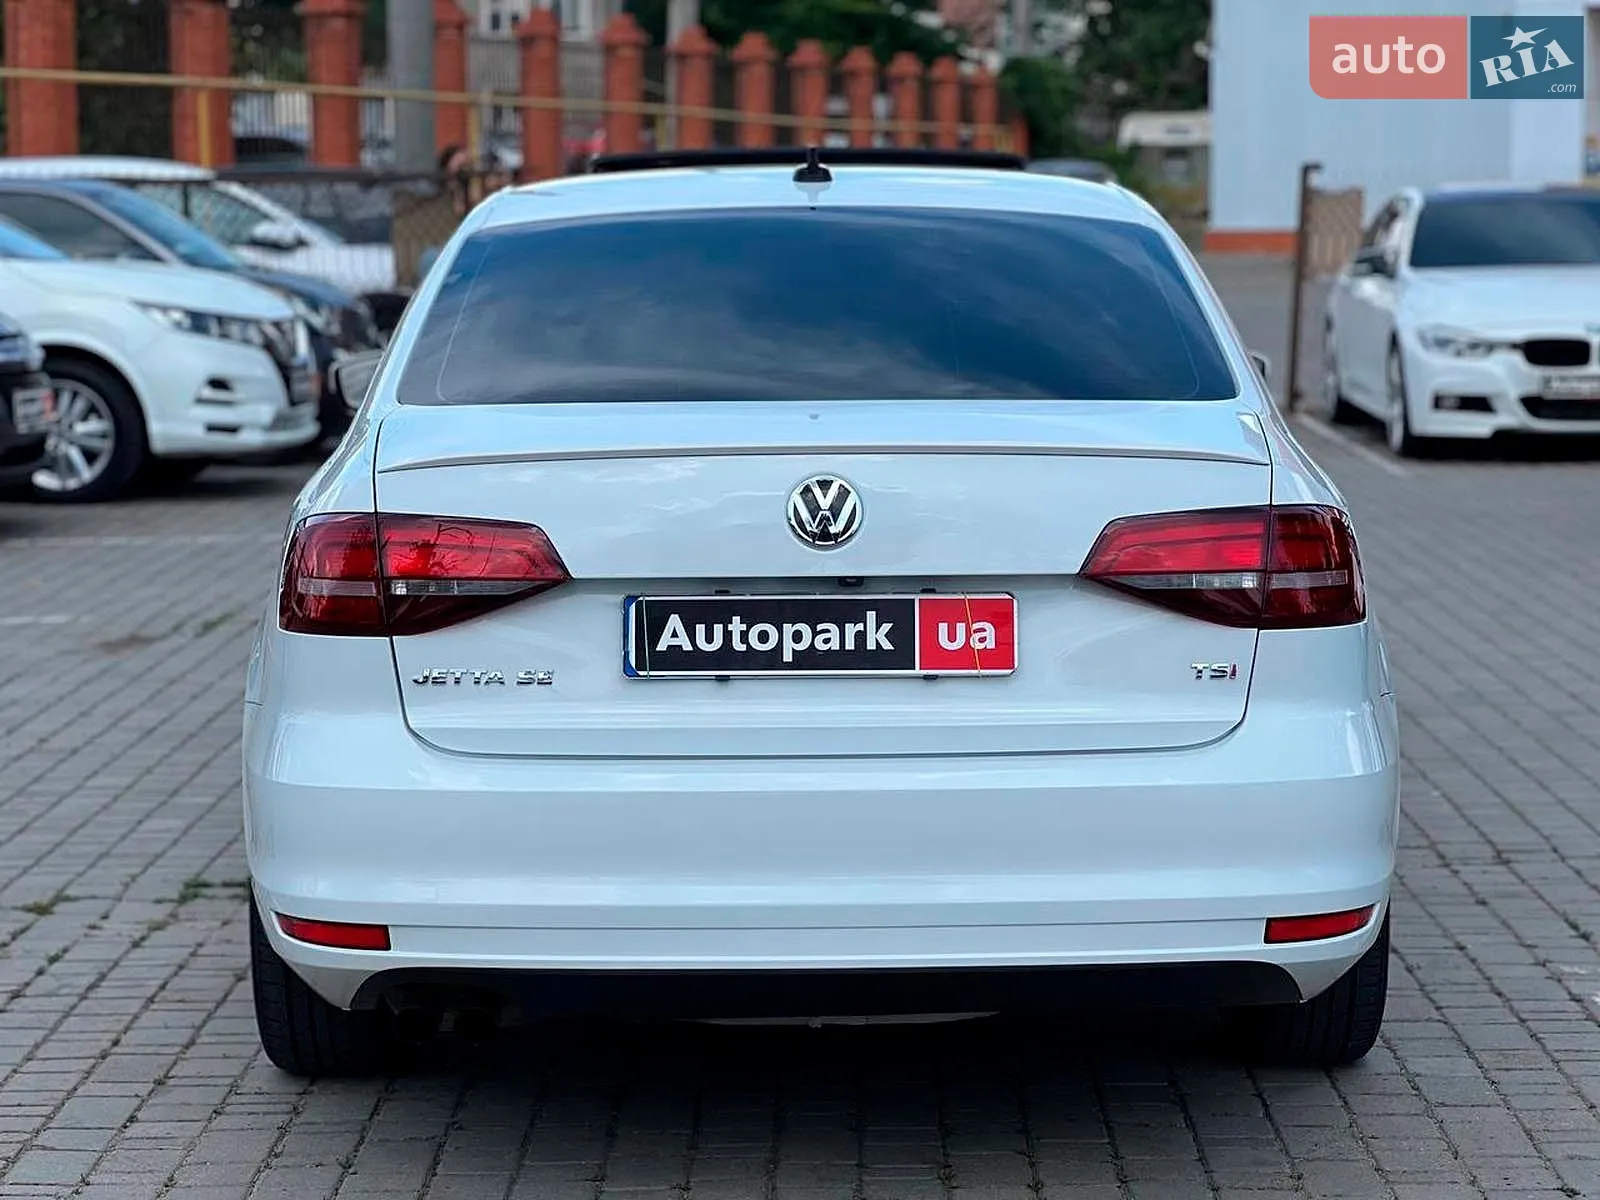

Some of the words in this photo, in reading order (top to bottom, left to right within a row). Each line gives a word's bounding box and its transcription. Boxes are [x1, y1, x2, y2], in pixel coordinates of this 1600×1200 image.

[655, 610, 896, 663] Autopark
[938, 620, 997, 650] ua
[412, 668, 505, 685] JETTA
[516, 669, 554, 685] SE
[1191, 663, 1237, 680] TSI
